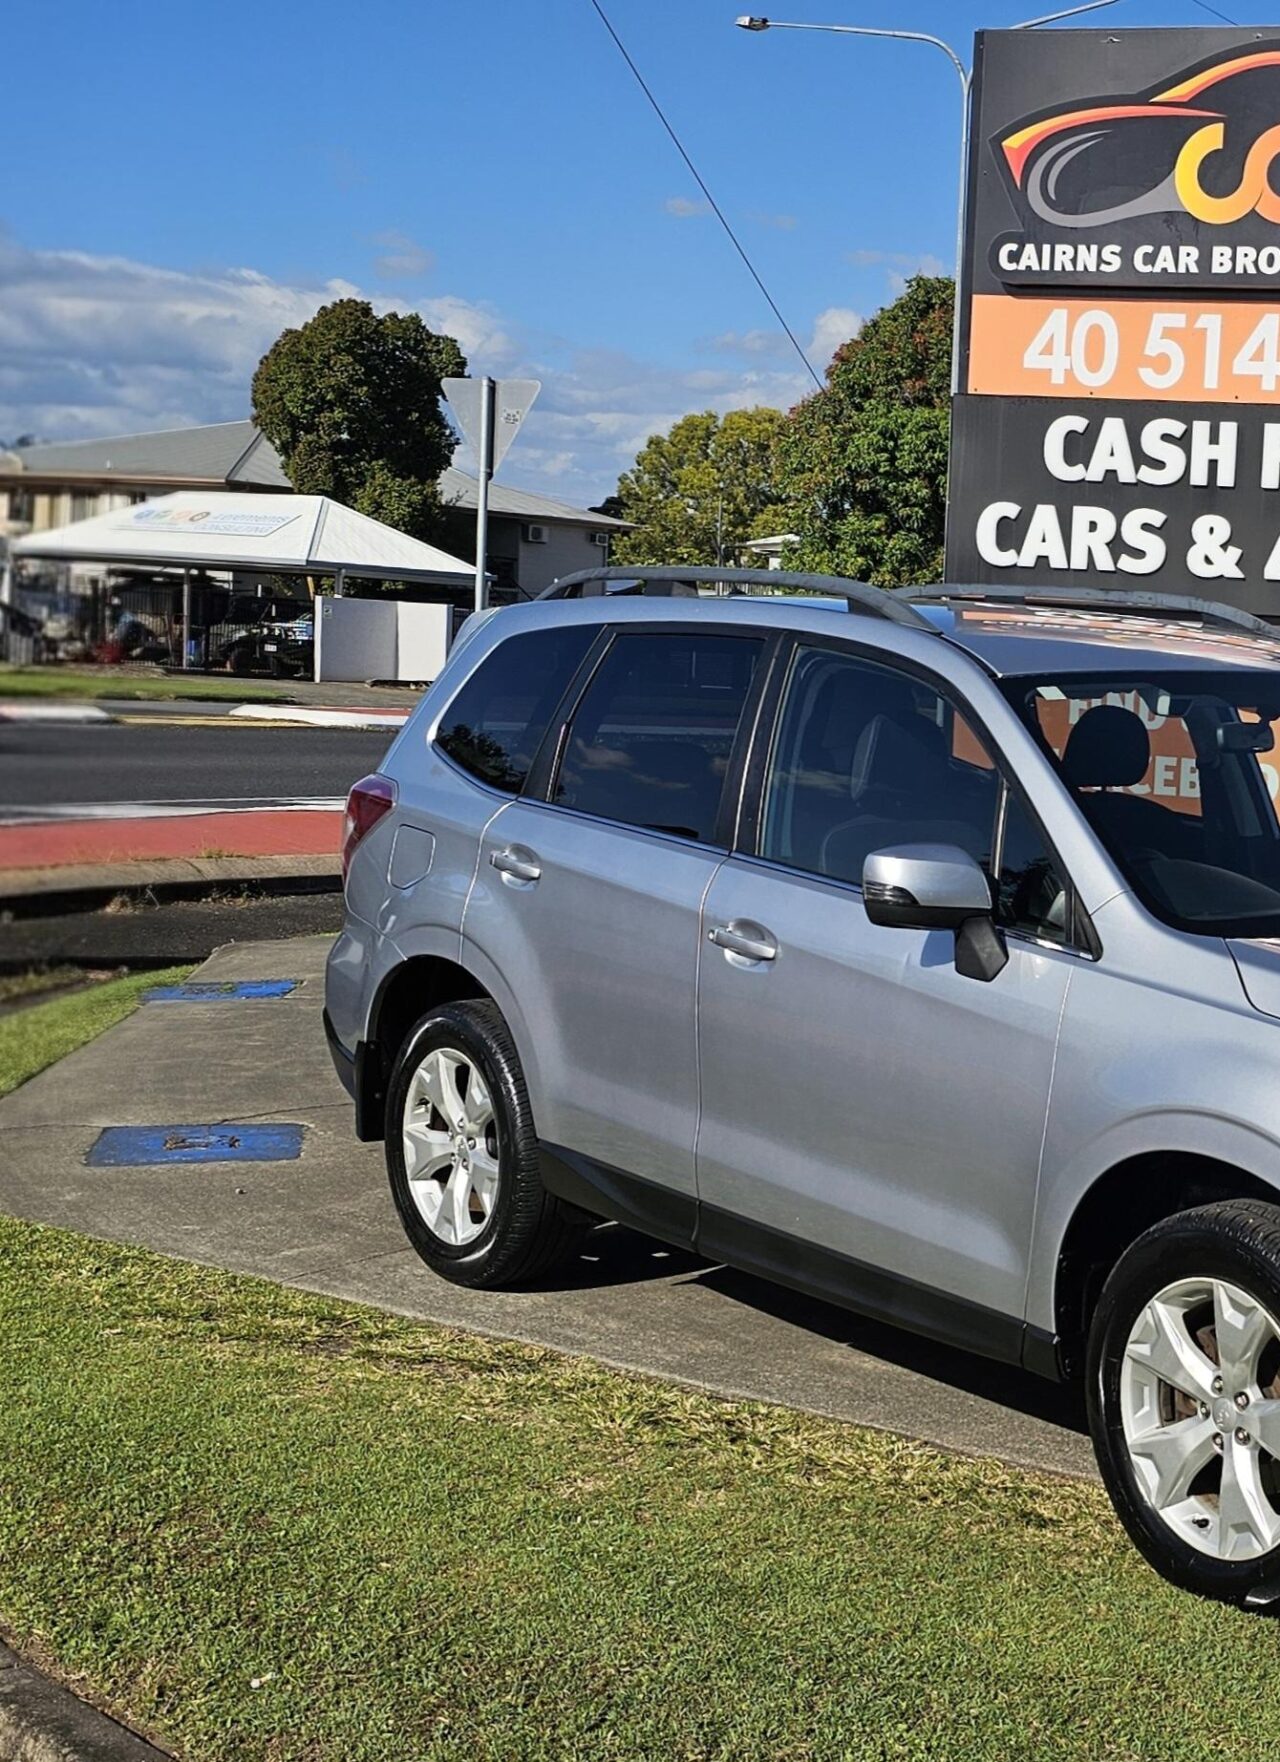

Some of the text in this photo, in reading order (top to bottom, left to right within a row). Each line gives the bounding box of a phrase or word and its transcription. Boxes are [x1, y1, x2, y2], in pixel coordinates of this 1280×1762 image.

[999, 243, 1122, 272] CAIRNS
[1133, 245, 1199, 274] CAR
[1023, 308, 1119, 387] 40
[1044, 415, 1238, 487] CASH
[976, 501, 1168, 574] CARS
[1186, 514, 1245, 578] &
